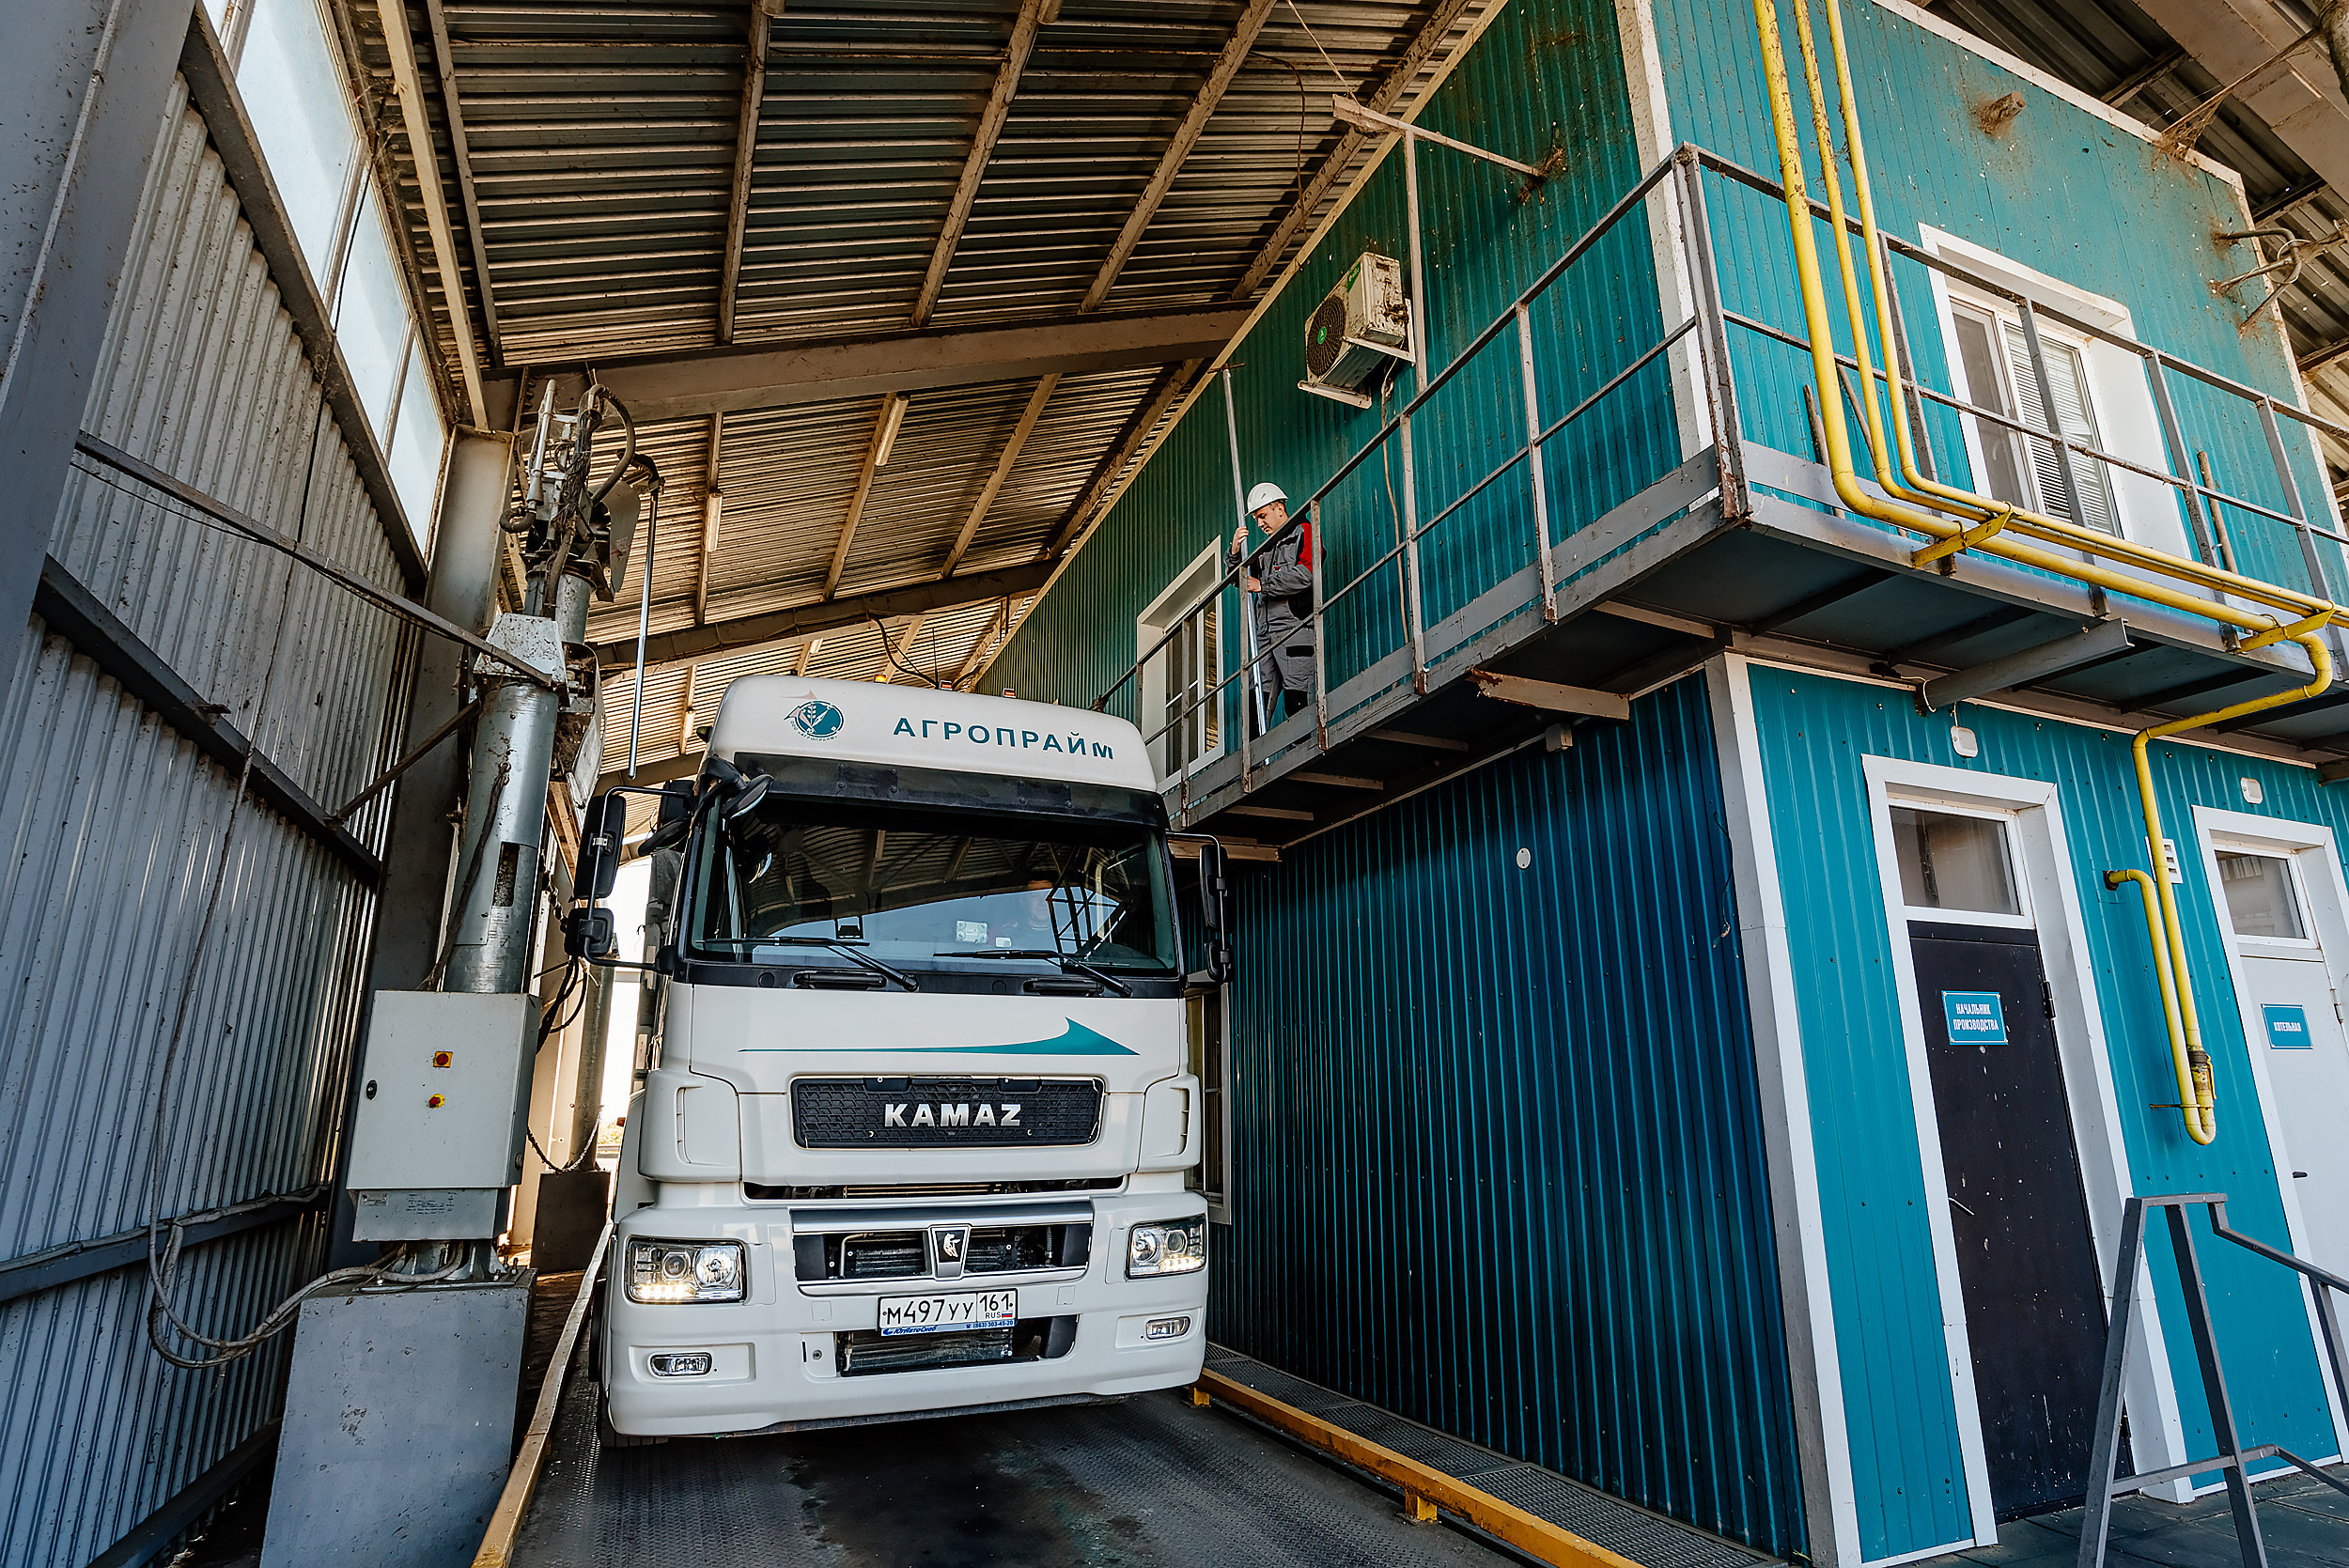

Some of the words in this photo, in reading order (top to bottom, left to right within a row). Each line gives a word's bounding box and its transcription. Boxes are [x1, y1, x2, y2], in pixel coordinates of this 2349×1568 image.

[894, 717, 1114, 760] АГРОПРАЙМ
[1955, 1003, 1991, 1015] НАЧАЛЬНИК
[1952, 1018, 1999, 1032] ПРОИЗВОДСТВА
[884, 1103, 1021, 1127] KAMAZ
[979, 1293, 1010, 1312] 161
